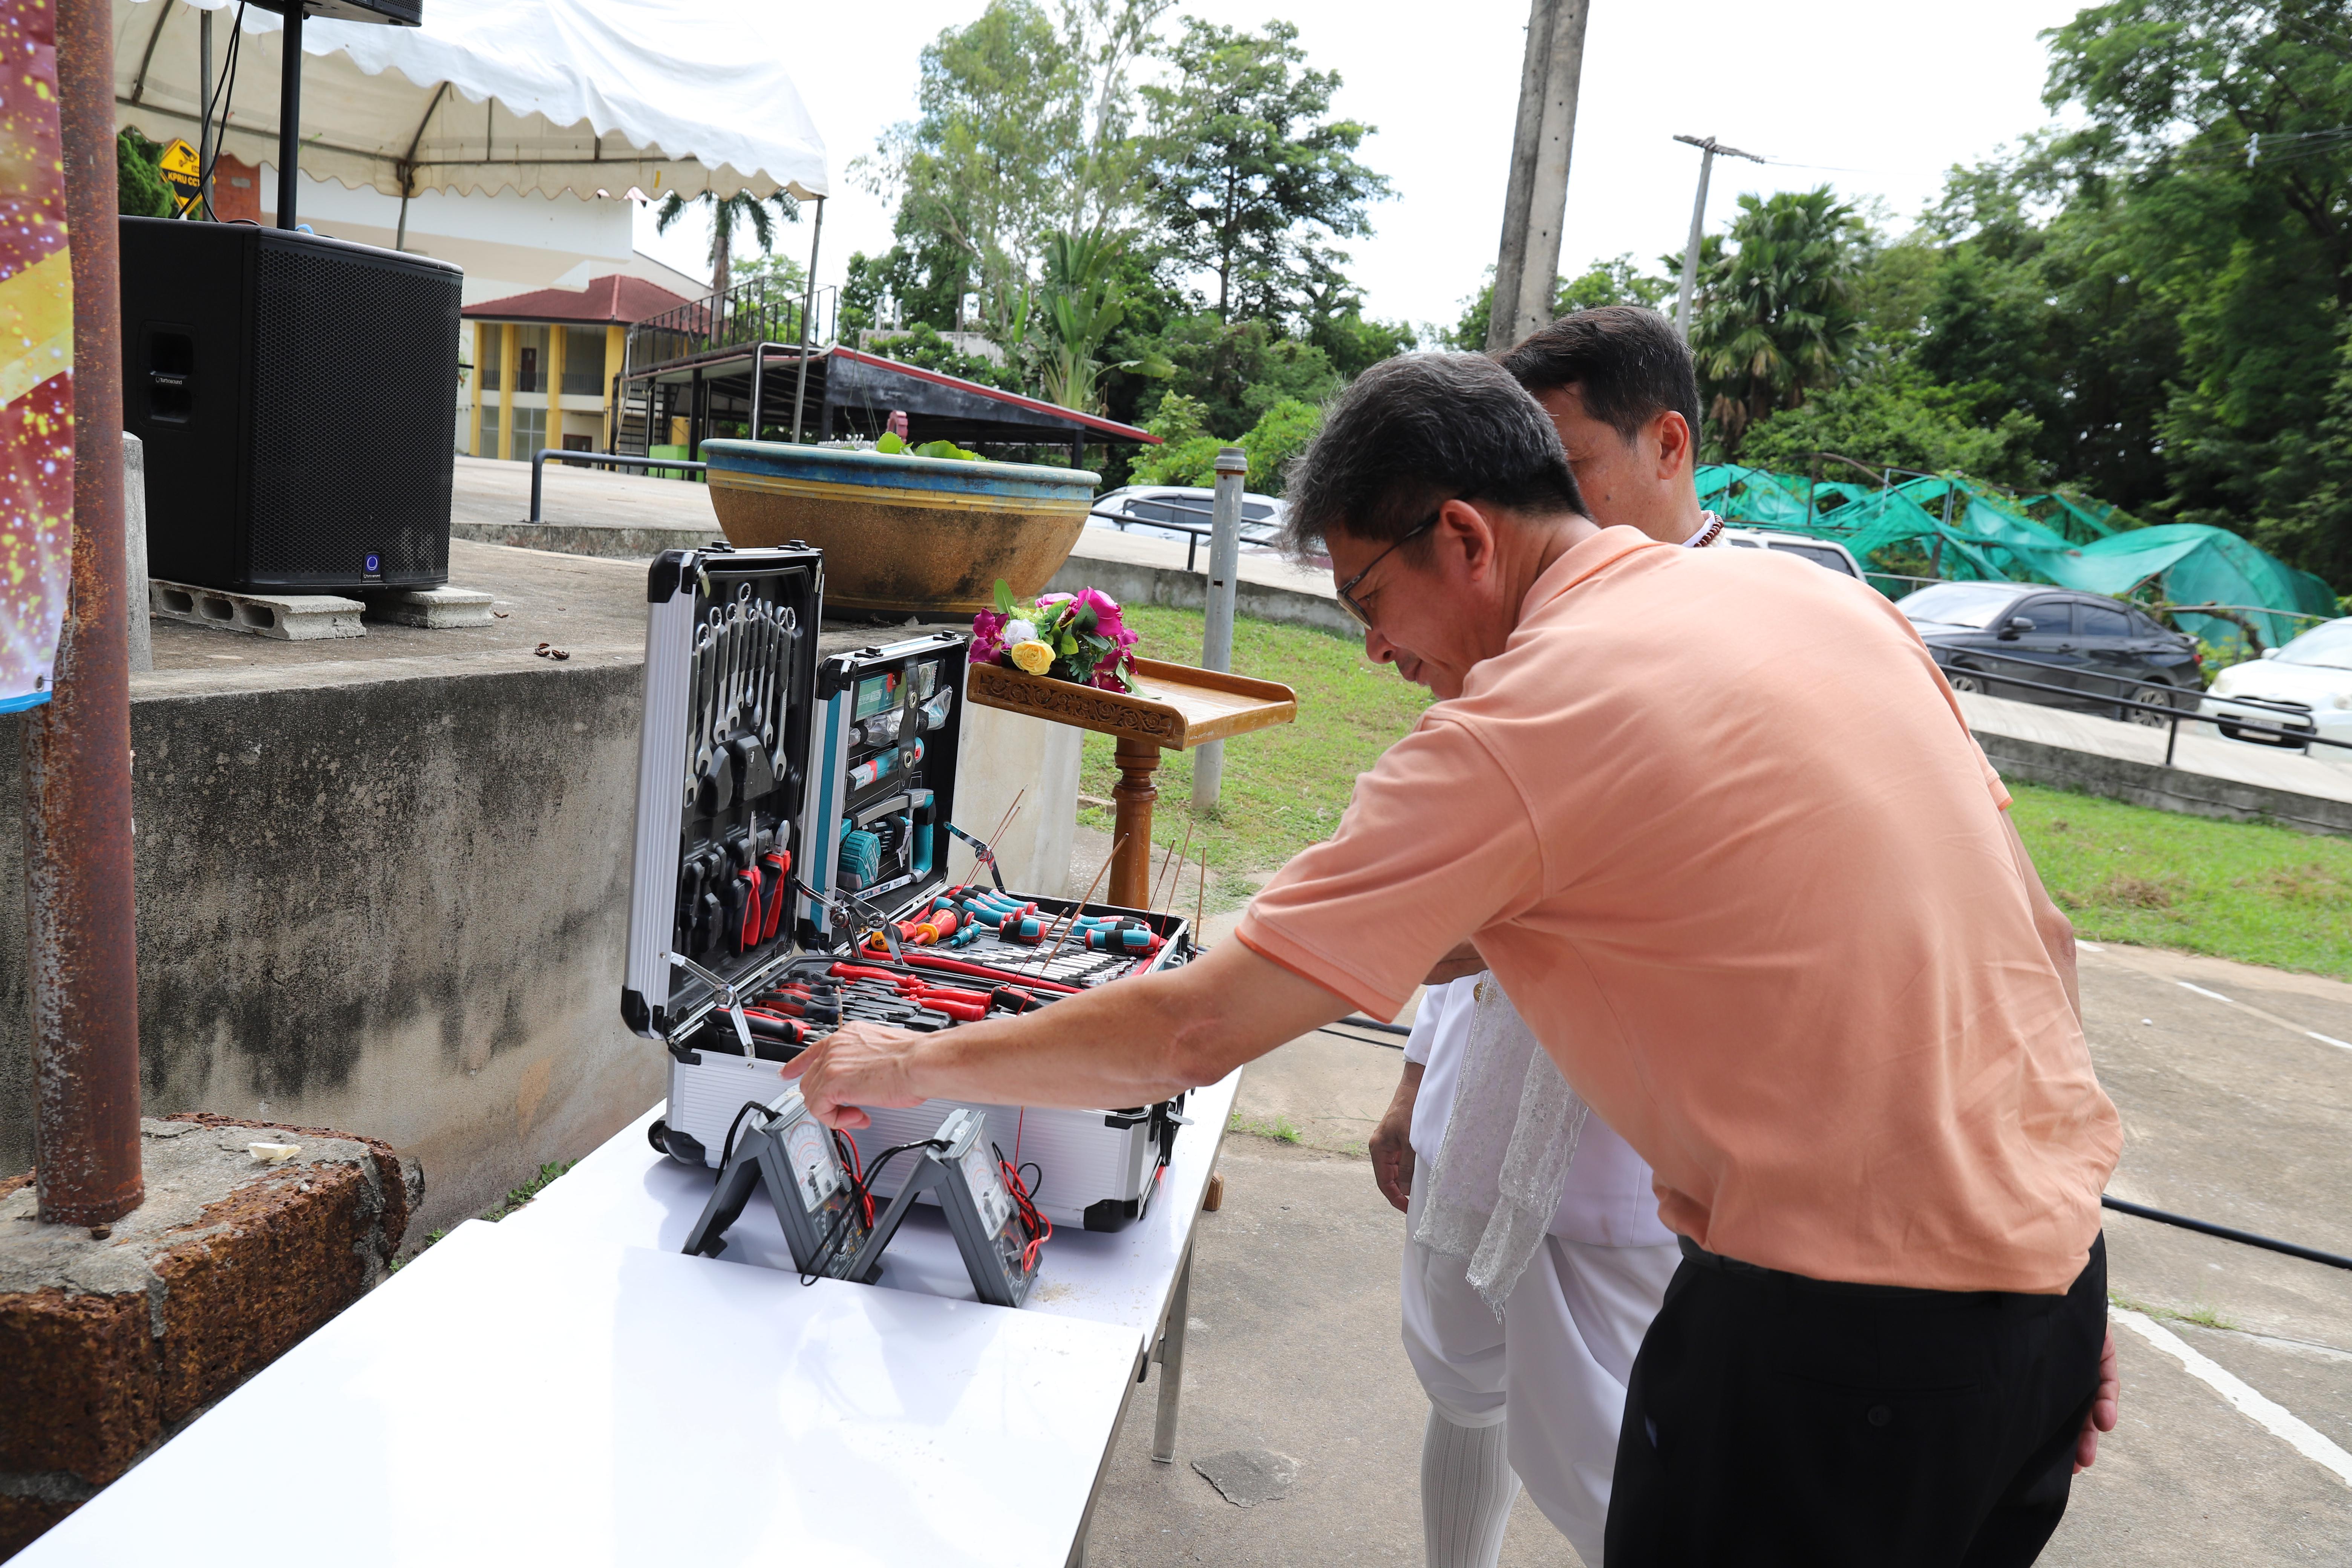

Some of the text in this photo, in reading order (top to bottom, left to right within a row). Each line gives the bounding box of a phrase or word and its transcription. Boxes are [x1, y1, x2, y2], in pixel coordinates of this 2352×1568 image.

[168, 172, 200, 187] KPRU CCT
[893, 879, 902, 887] TOTAL
